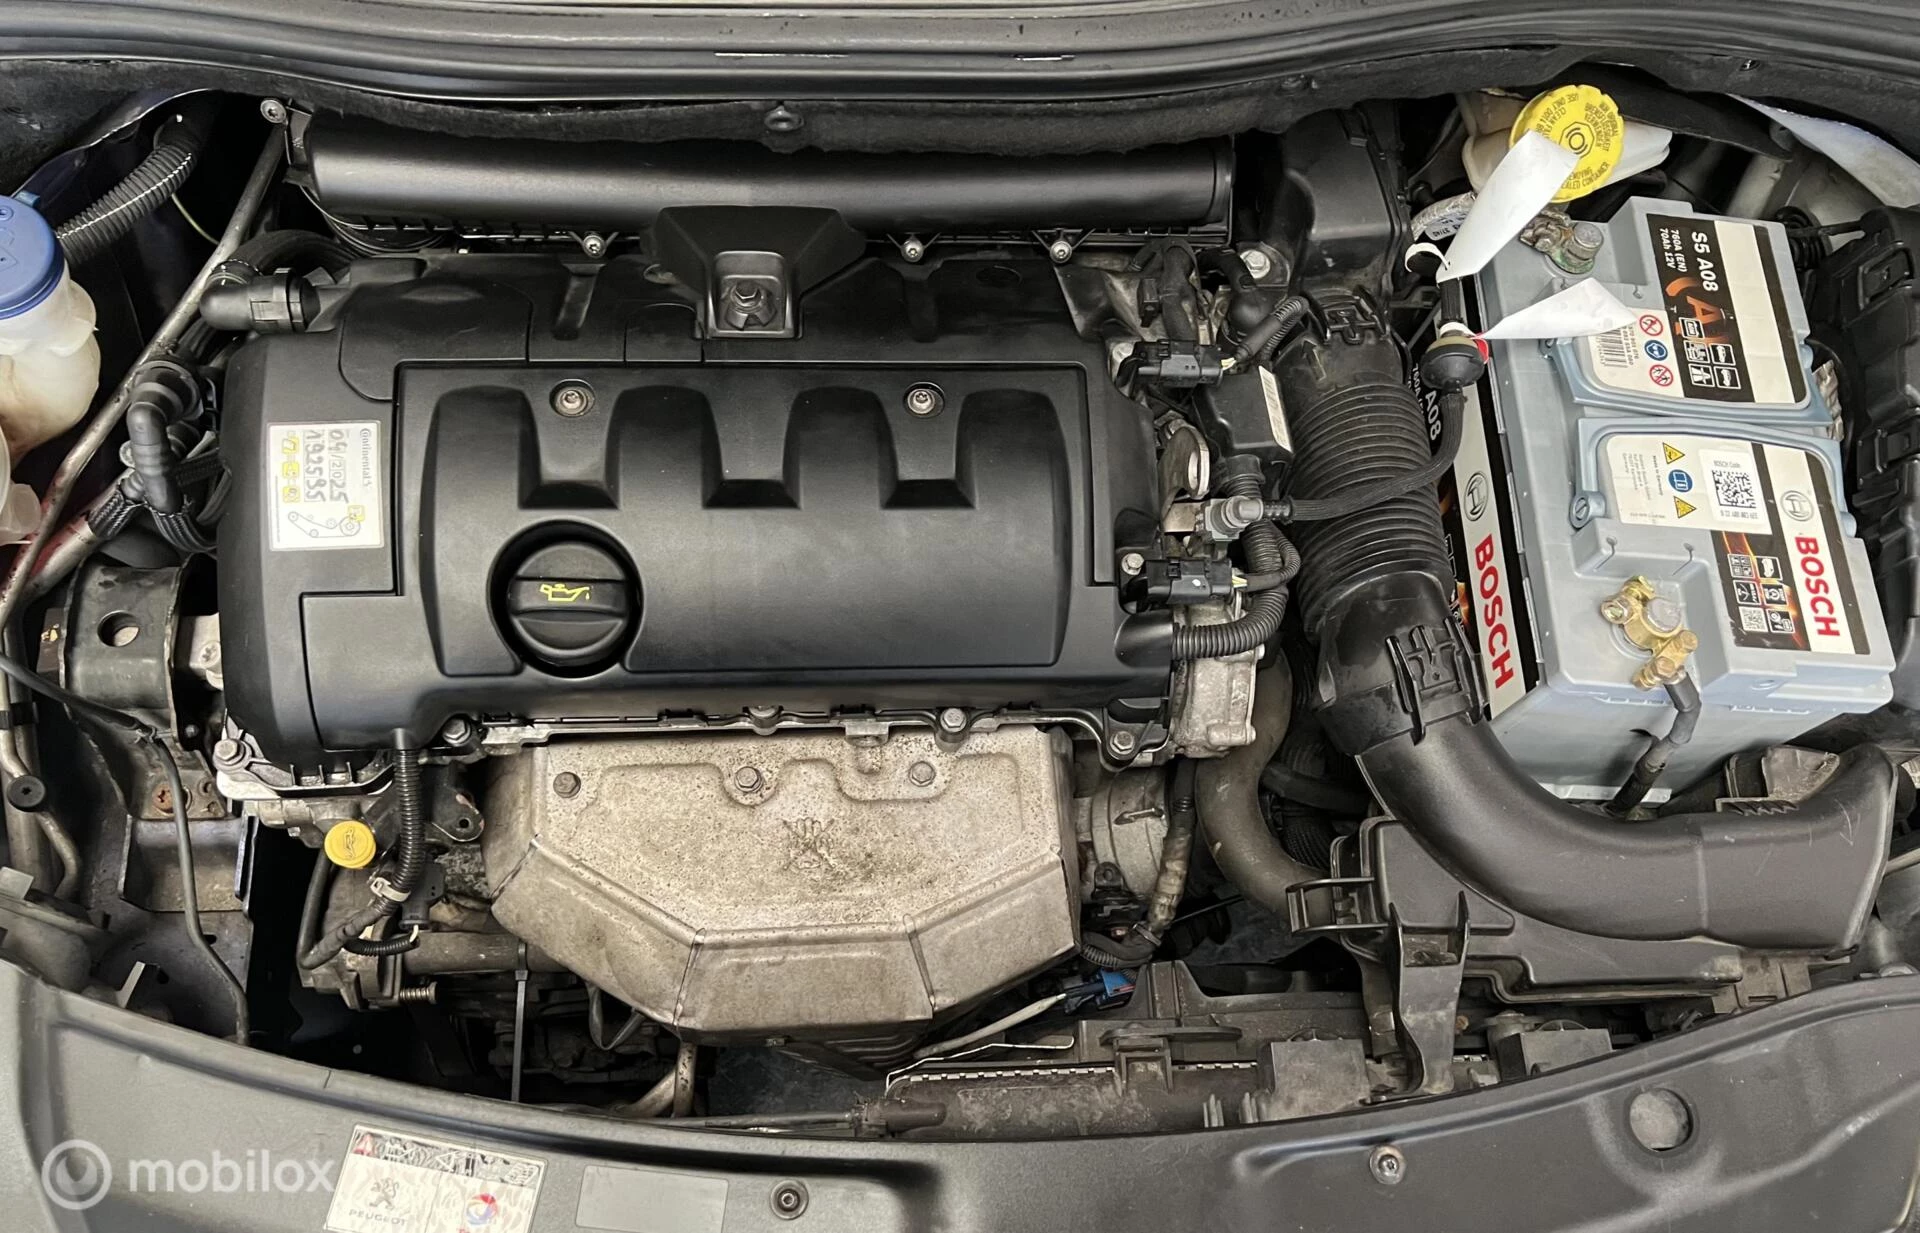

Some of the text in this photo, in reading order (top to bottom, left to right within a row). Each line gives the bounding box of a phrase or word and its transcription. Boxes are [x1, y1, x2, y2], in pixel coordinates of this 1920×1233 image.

[1660, 228, 1675, 268] 70Ah 12V
[1671, 230, 1687, 271] 760A (EN)
[1691, 232, 1719, 291] S5 A08
[1424, 391, 1442, 440] A08
[359, 428, 373, 481] Continental
[1475, 534, 1514, 689] BOSCH
[1795, 536, 1840, 637] BOSCH
[348, 1208, 406, 1226] PEUGEOT
